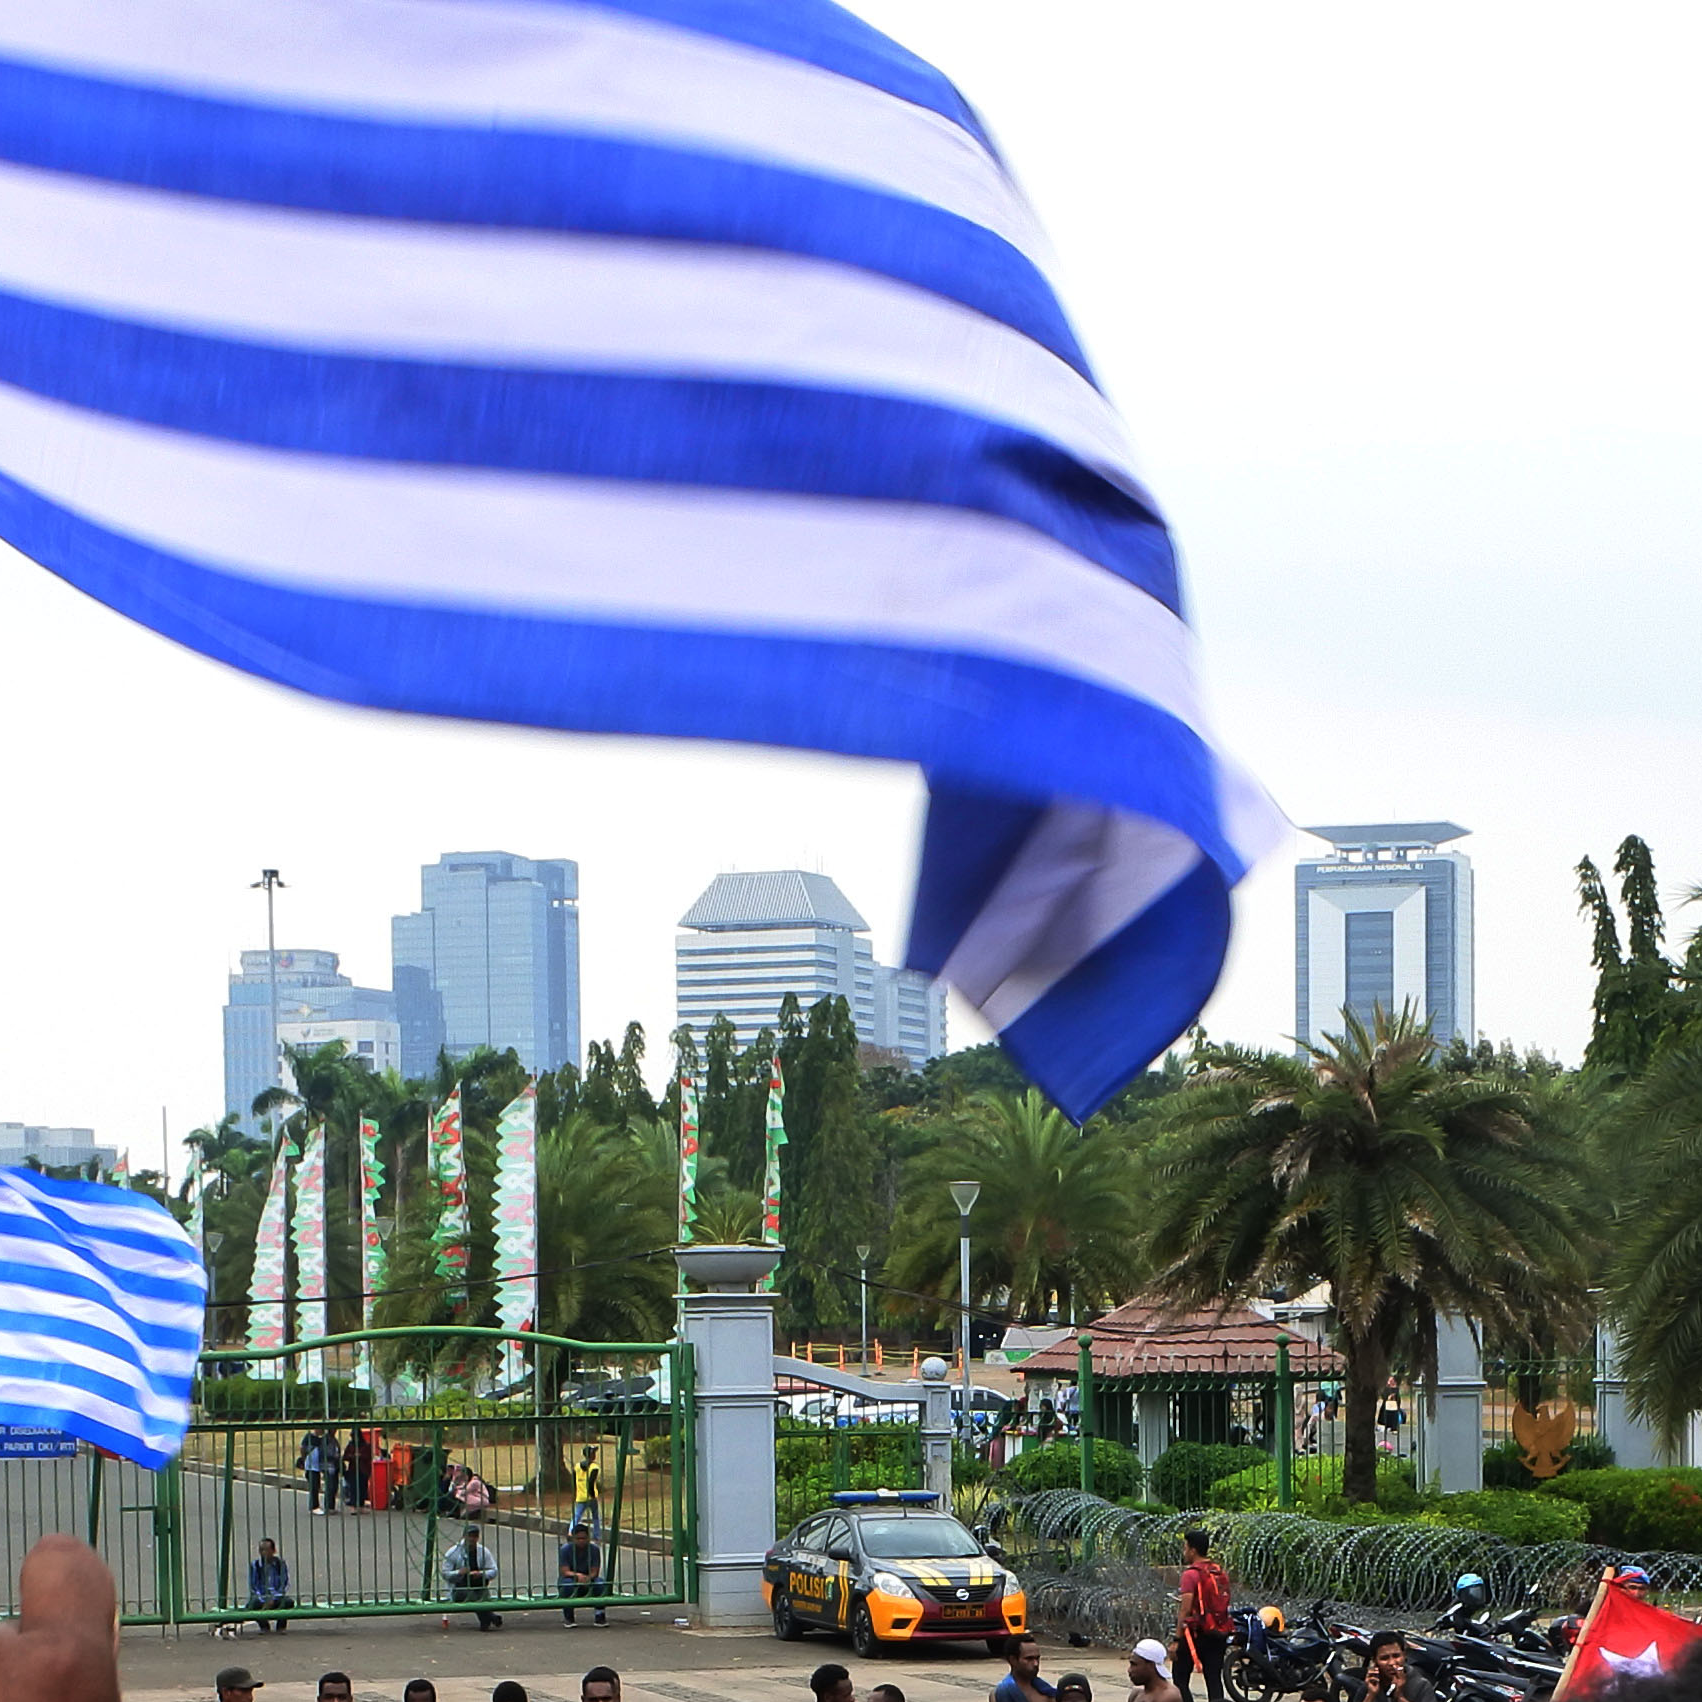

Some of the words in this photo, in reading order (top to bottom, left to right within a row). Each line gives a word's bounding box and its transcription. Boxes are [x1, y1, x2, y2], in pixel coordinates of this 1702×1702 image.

[1316, 864, 1373, 873] PERPUSTAKAAN
[1375, 863, 1411, 872] NASIONAL
[789, 1571, 826, 1600] POLISI
